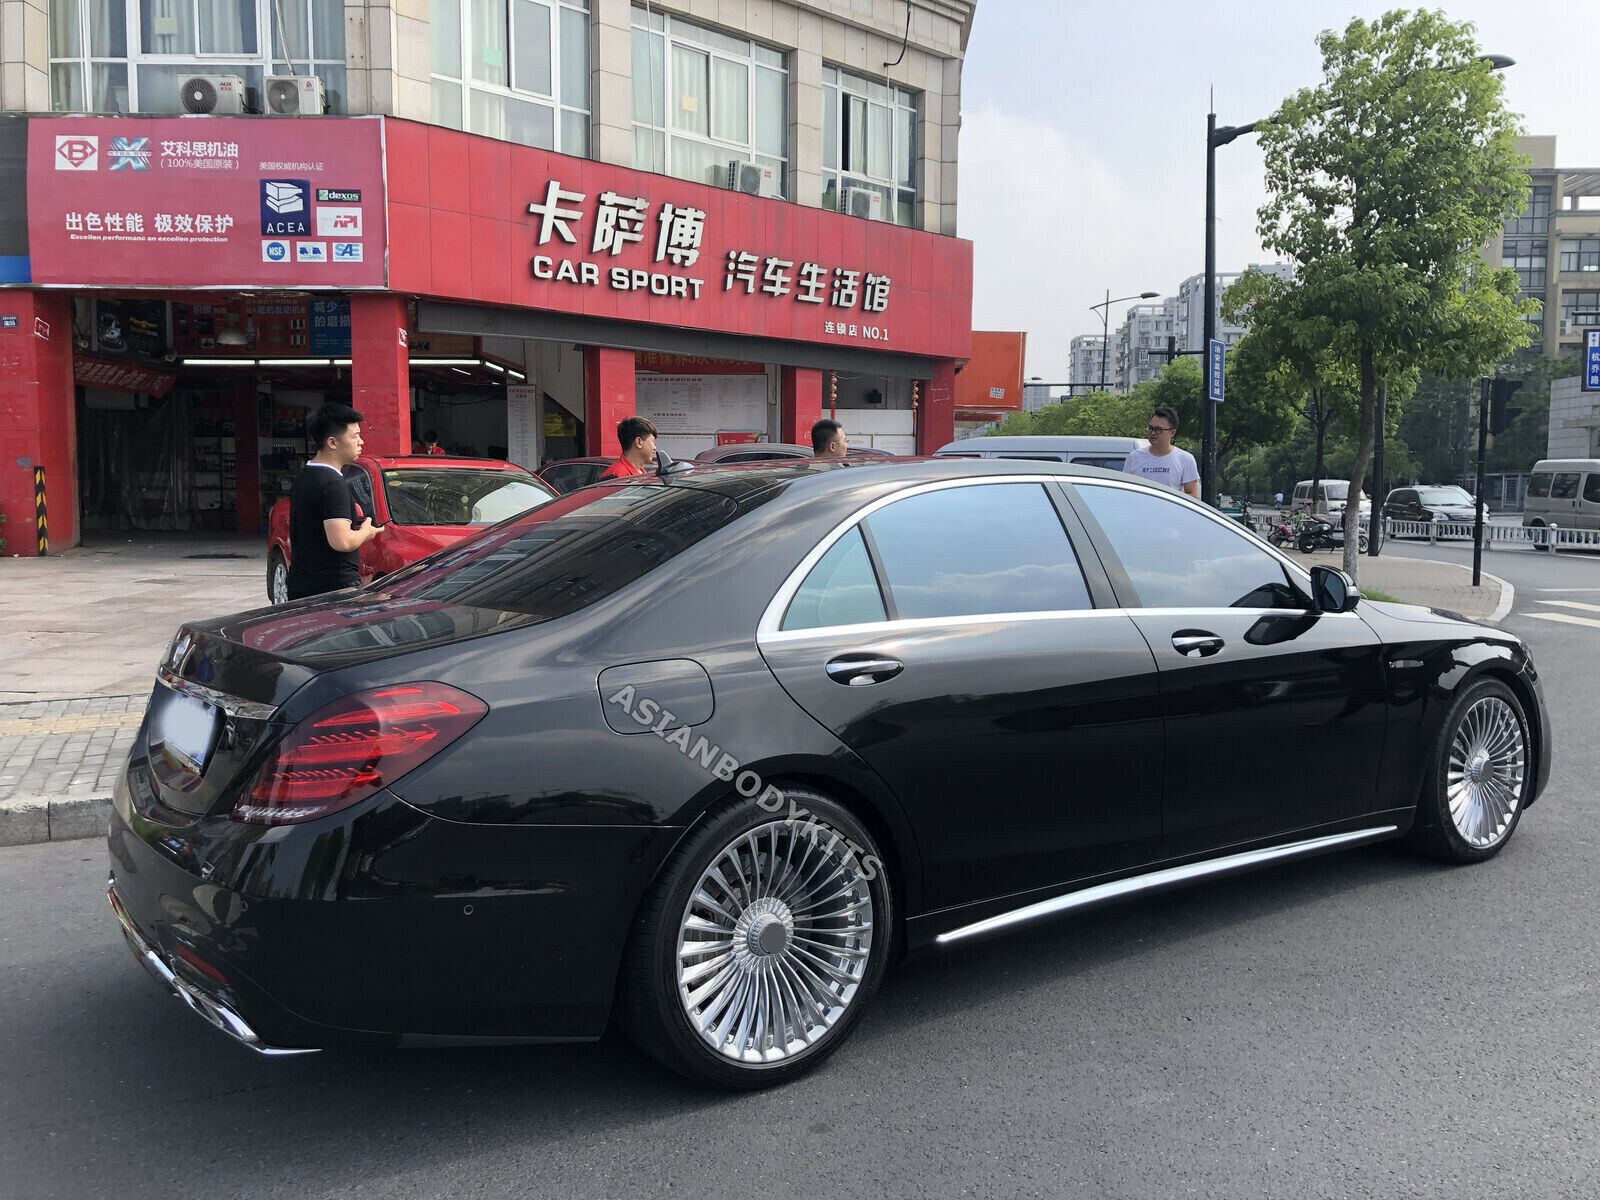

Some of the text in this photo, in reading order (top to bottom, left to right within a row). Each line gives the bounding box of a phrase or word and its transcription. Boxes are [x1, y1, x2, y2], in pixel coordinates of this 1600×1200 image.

[160, 141, 239, 157] 艾科思机油
[328, 191, 360, 201] dexos
[65, 211, 234, 233] 出色性能 极效保护
[266, 222, 305, 234] ACEA
[529, 179, 707, 267] 卡萨博
[335, 243, 360, 257] SAE
[532, 255, 705, 300] CAR SPORT
[726, 250, 891, 312] 汽车生活馆
[824, 321, 889, 341] 连锁店 NO.1
[1590, 352, 1600, 385] 杭乔路
